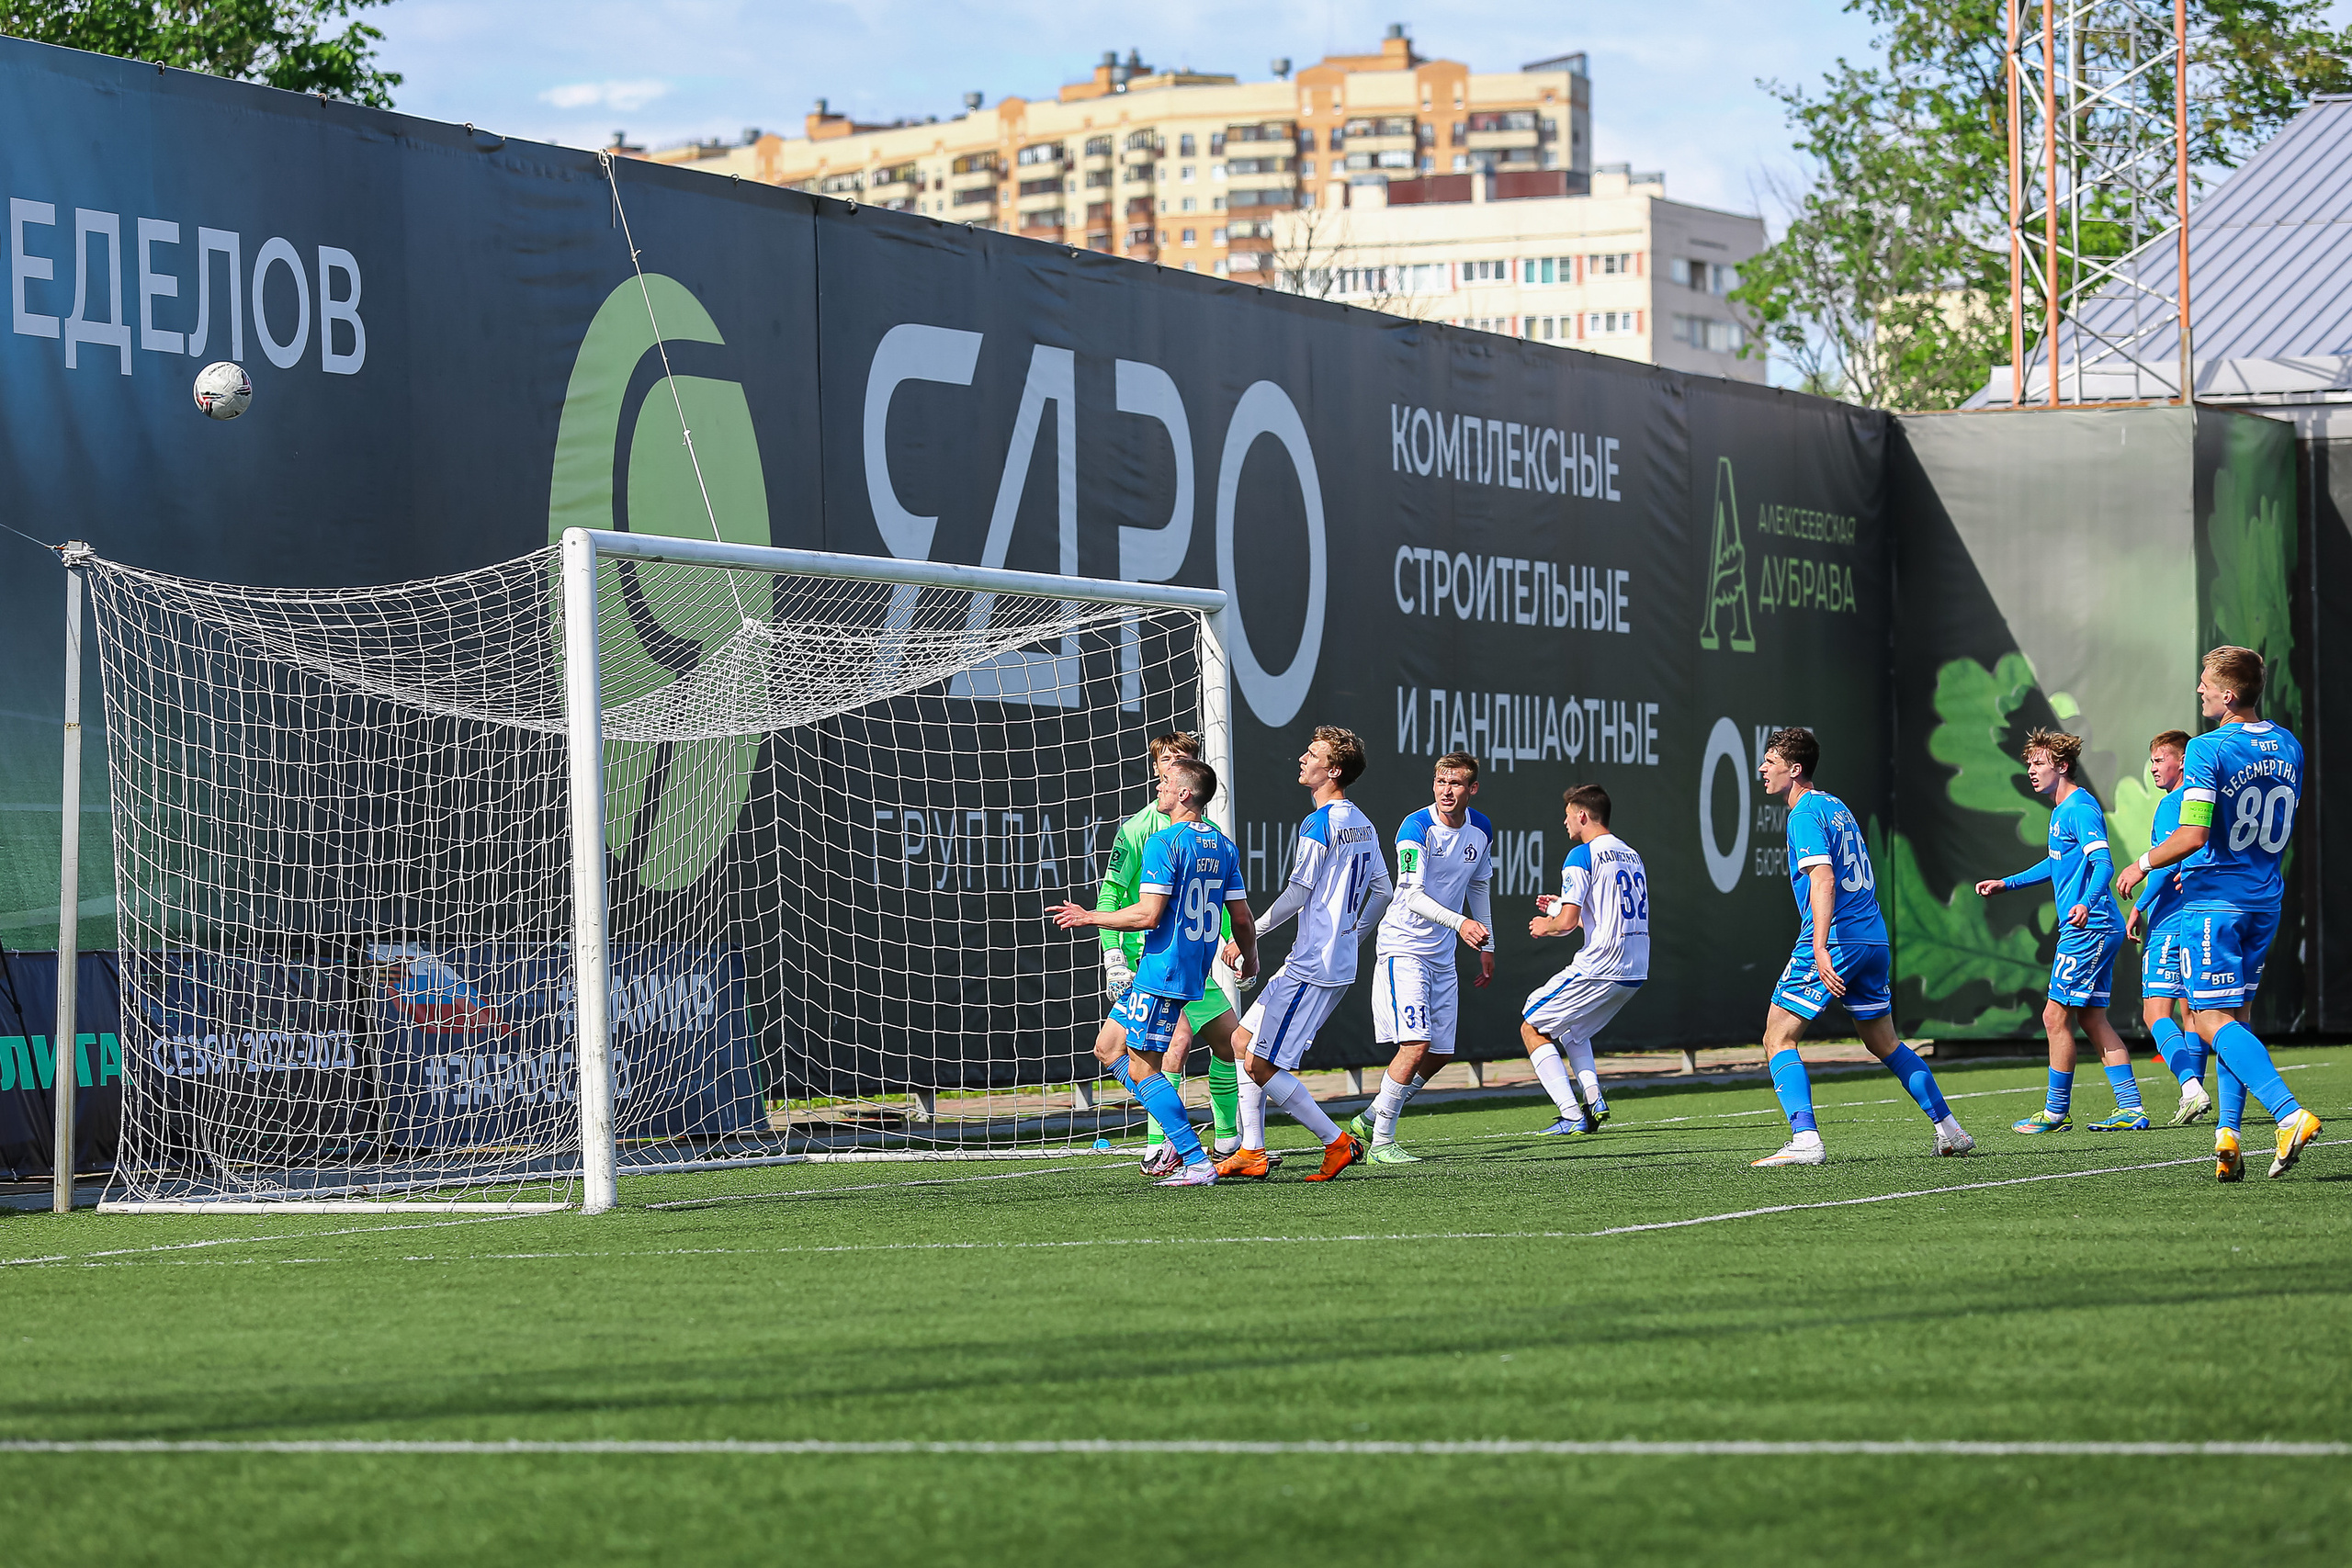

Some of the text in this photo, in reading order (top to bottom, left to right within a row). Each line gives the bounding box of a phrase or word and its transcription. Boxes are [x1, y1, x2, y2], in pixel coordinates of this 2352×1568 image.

[1391, 403, 1621, 502] КОМПЛЕКСНЫЕ
[1758, 502, 1856, 545] АЛЕКСЕЕВСКАЯ
[1394, 544, 1630, 633] СТРОИТЕЛЬНЫЕ
[1758, 554, 1857, 614] ДУБРАВА
[1397, 686, 1659, 773] И ЛАНДШАФТНЫЕ
[2258, 739, 2278, 751] ВТБ
[2229, 786, 2295, 853] 80
[874, 810, 1059, 889] ГРУППА
[1196, 858, 1220, 874] БЕГУН
[1203, 839, 1217, 850] ВТБ
[1841, 831, 1874, 893] 56
[1184, 877, 1224, 942] 95
[1616, 870, 1646, 919] 32
[2201, 917, 2211, 965] BetBoom
[2054, 953, 2077, 981] 72
[2211, 972, 2235, 986] ВТБ
[1127, 992, 1150, 1022] 95
[1404, 1005, 1426, 1030] 31
[1804, 987, 1823, 1001] ВТБ
[153, 1029, 356, 1075] СЕЗОН 2022-2023
